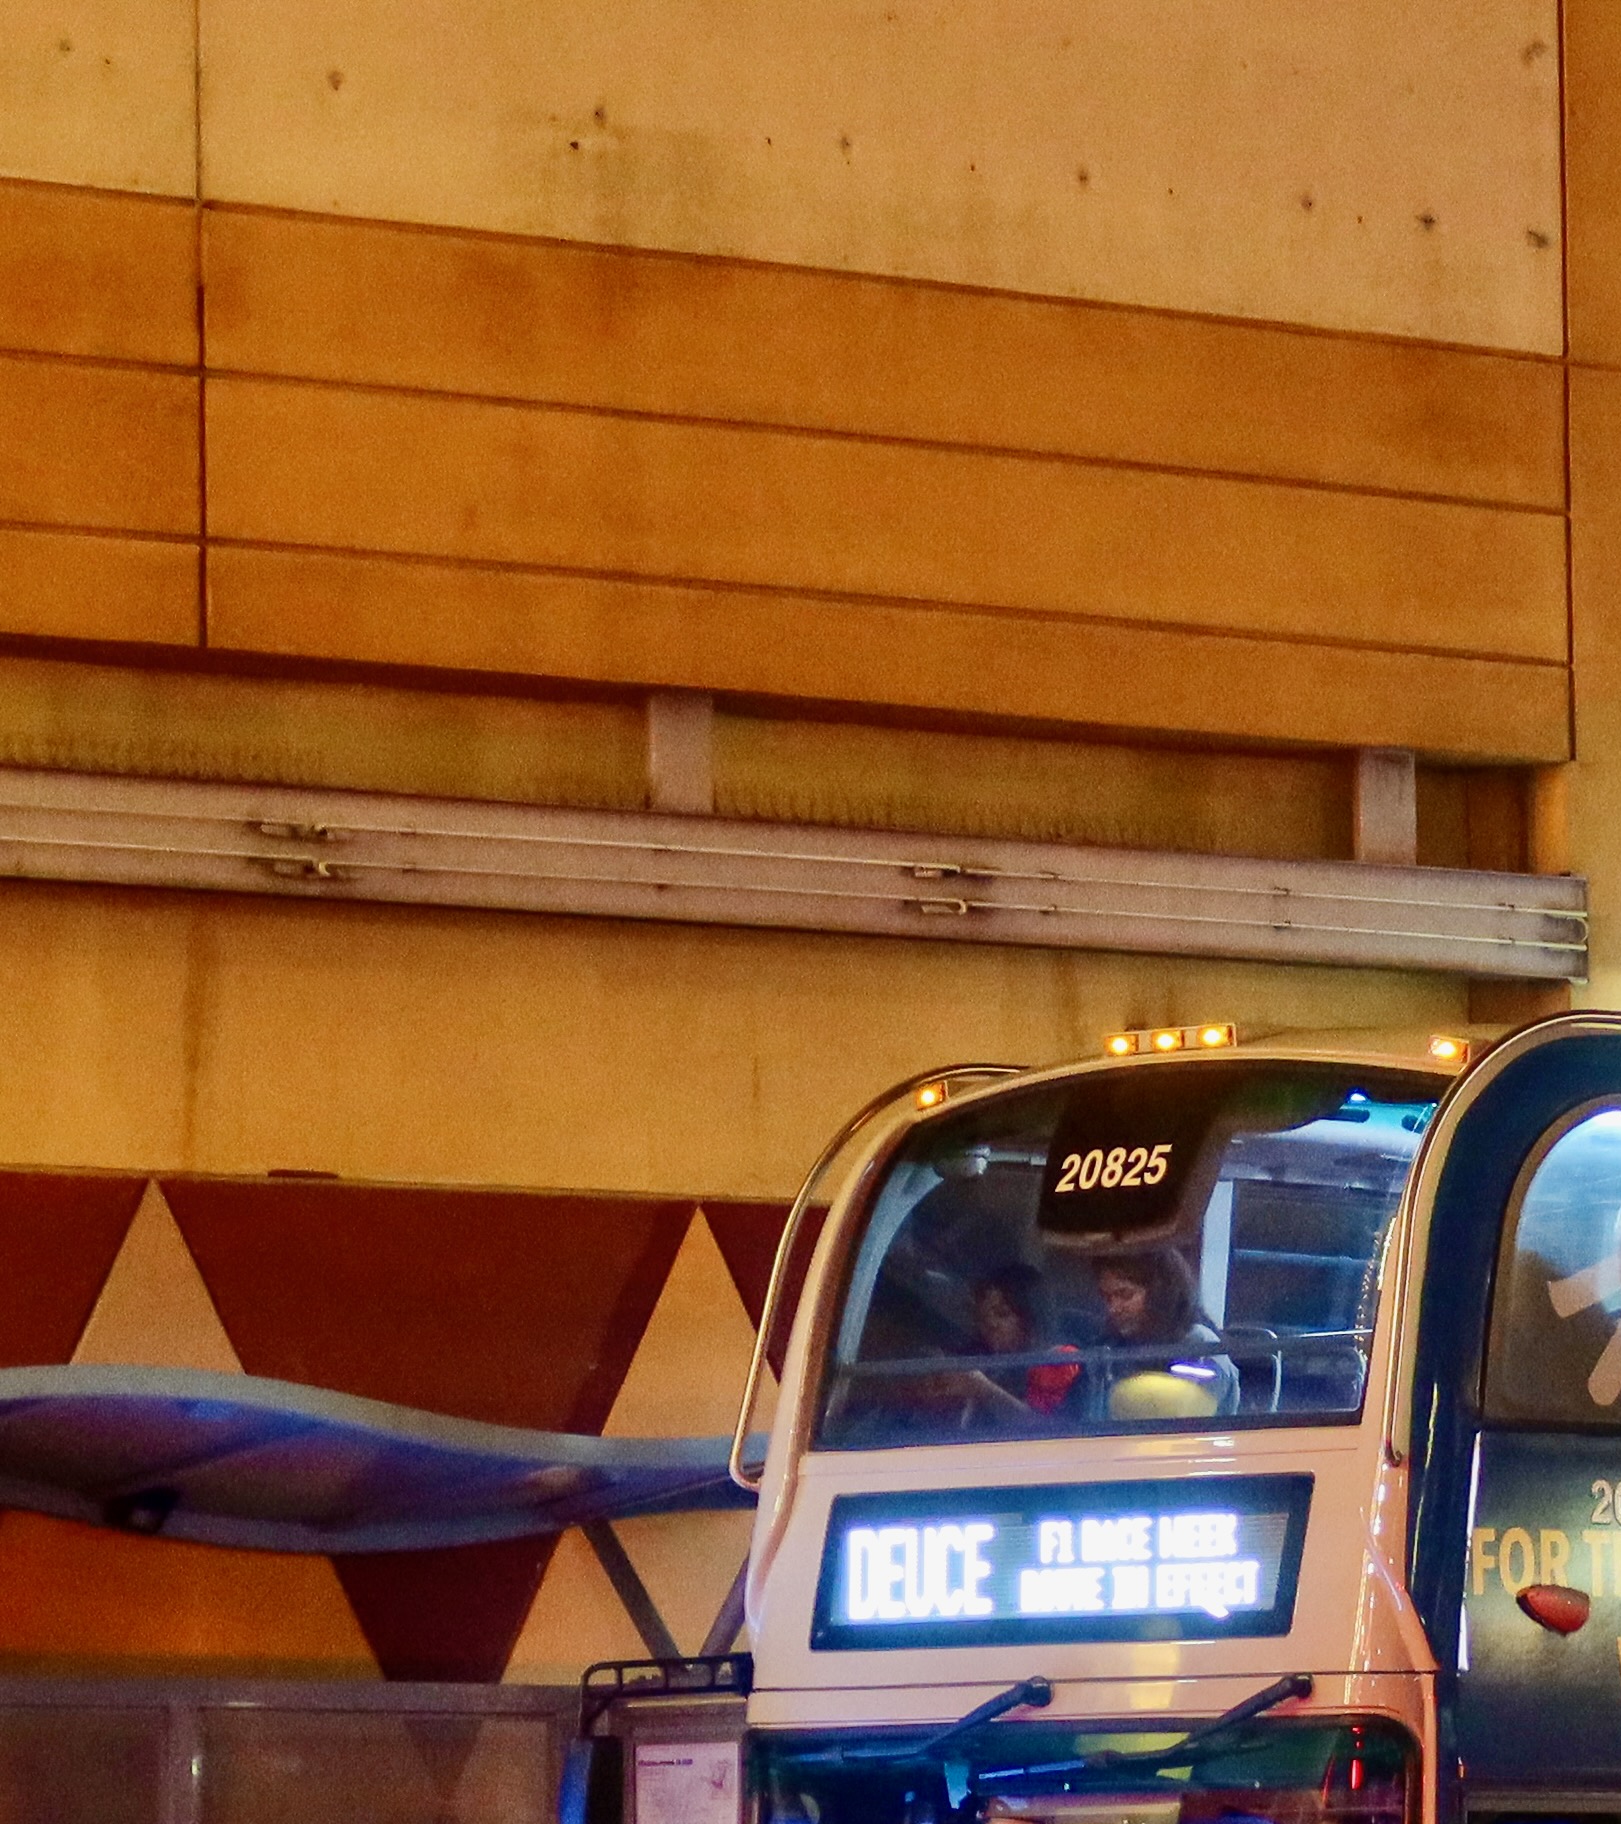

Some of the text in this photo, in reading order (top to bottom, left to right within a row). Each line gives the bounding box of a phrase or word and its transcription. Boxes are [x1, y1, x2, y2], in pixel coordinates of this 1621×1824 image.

[1055, 1144, 1171, 1193] 20825
[849, 1523, 994, 1620] DEUCE
[1470, 1526, 1572, 1597] FOR
